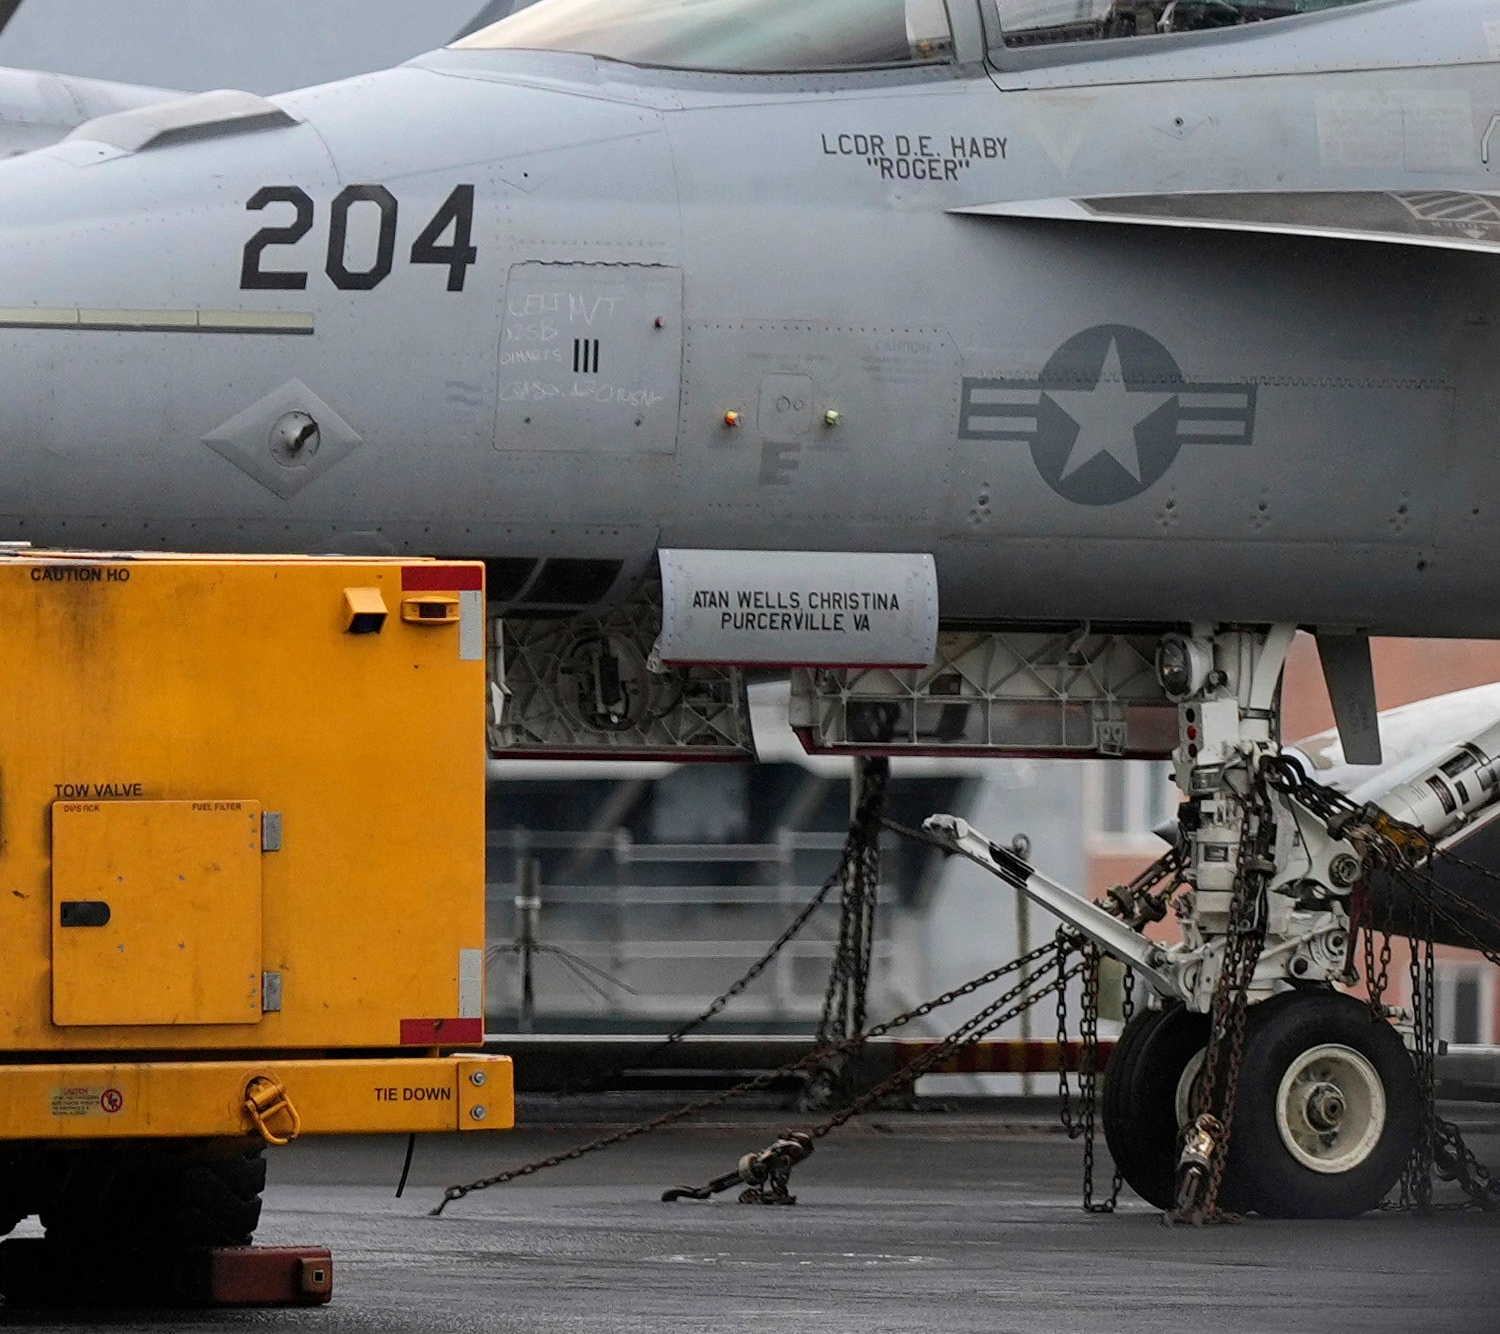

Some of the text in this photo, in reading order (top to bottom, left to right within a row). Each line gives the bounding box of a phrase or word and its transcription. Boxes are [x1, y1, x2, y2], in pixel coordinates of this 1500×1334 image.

[821, 134, 1008, 159] LCDR D.E. HABY
[866, 157, 970, 181] "ROGER"
[239, 184, 477, 292] 204
[30, 568, 101, 581] CAUTION
[692, 590, 730, 608] ATAN
[808, 592, 900, 610] CHRISTINA
[853, 614, 871, 631] VA
[54, 783, 142, 797] TOW VALVE
[192, 802, 242, 811] FUEL FILTER
[374, 1087, 451, 1101] TIE DOWN
